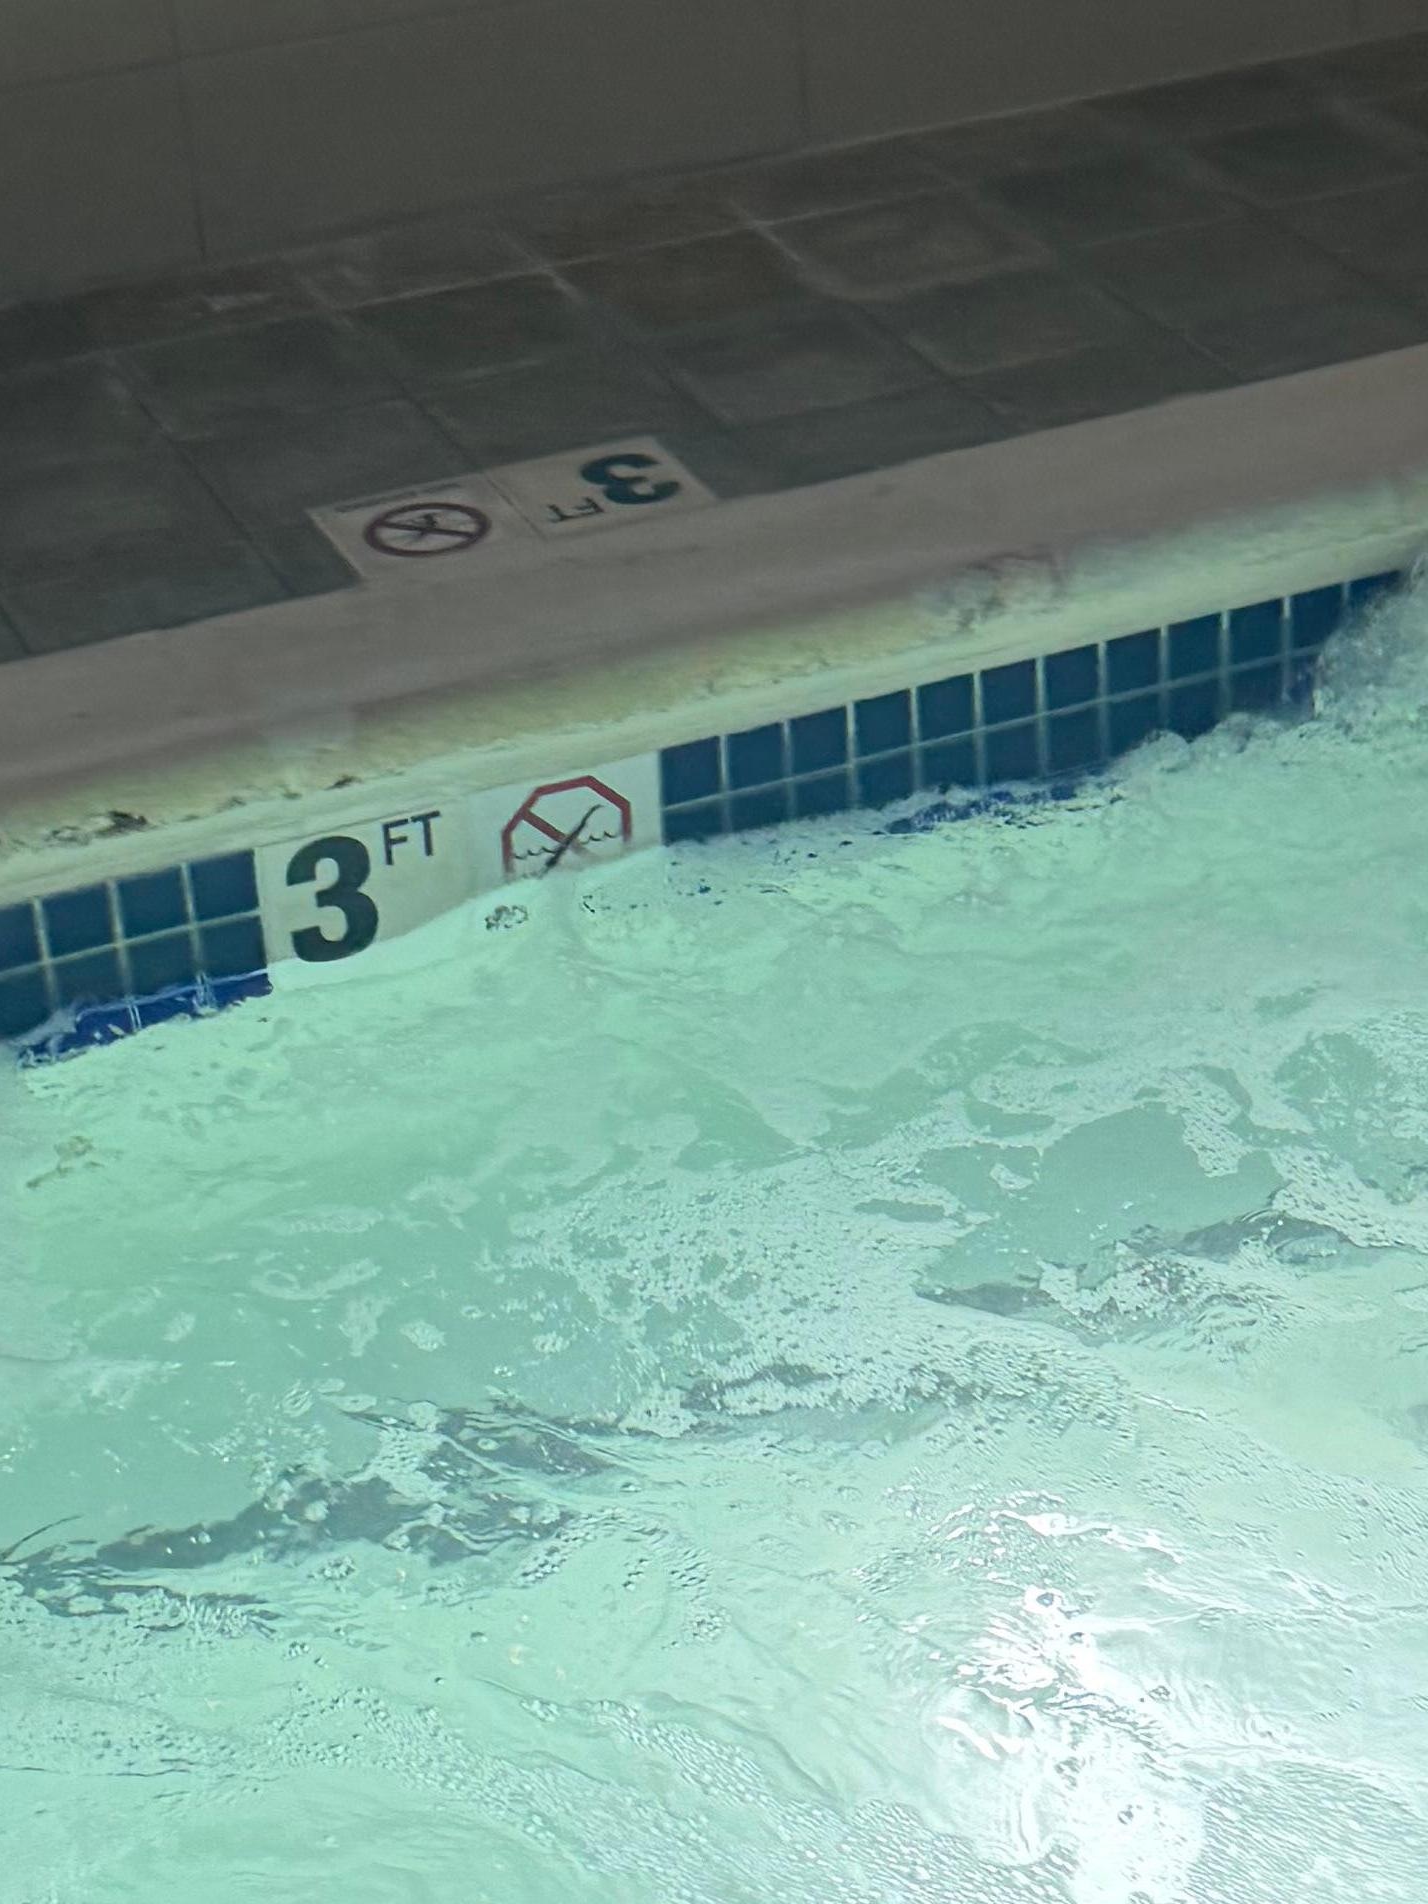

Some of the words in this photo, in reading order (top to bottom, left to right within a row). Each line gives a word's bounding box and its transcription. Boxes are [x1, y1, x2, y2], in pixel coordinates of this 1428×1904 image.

[581, 452, 682, 506] 3
[545, 495, 606, 525] FT
[285, 835, 380, 963] 3
[380, 810, 442, 867] FT
